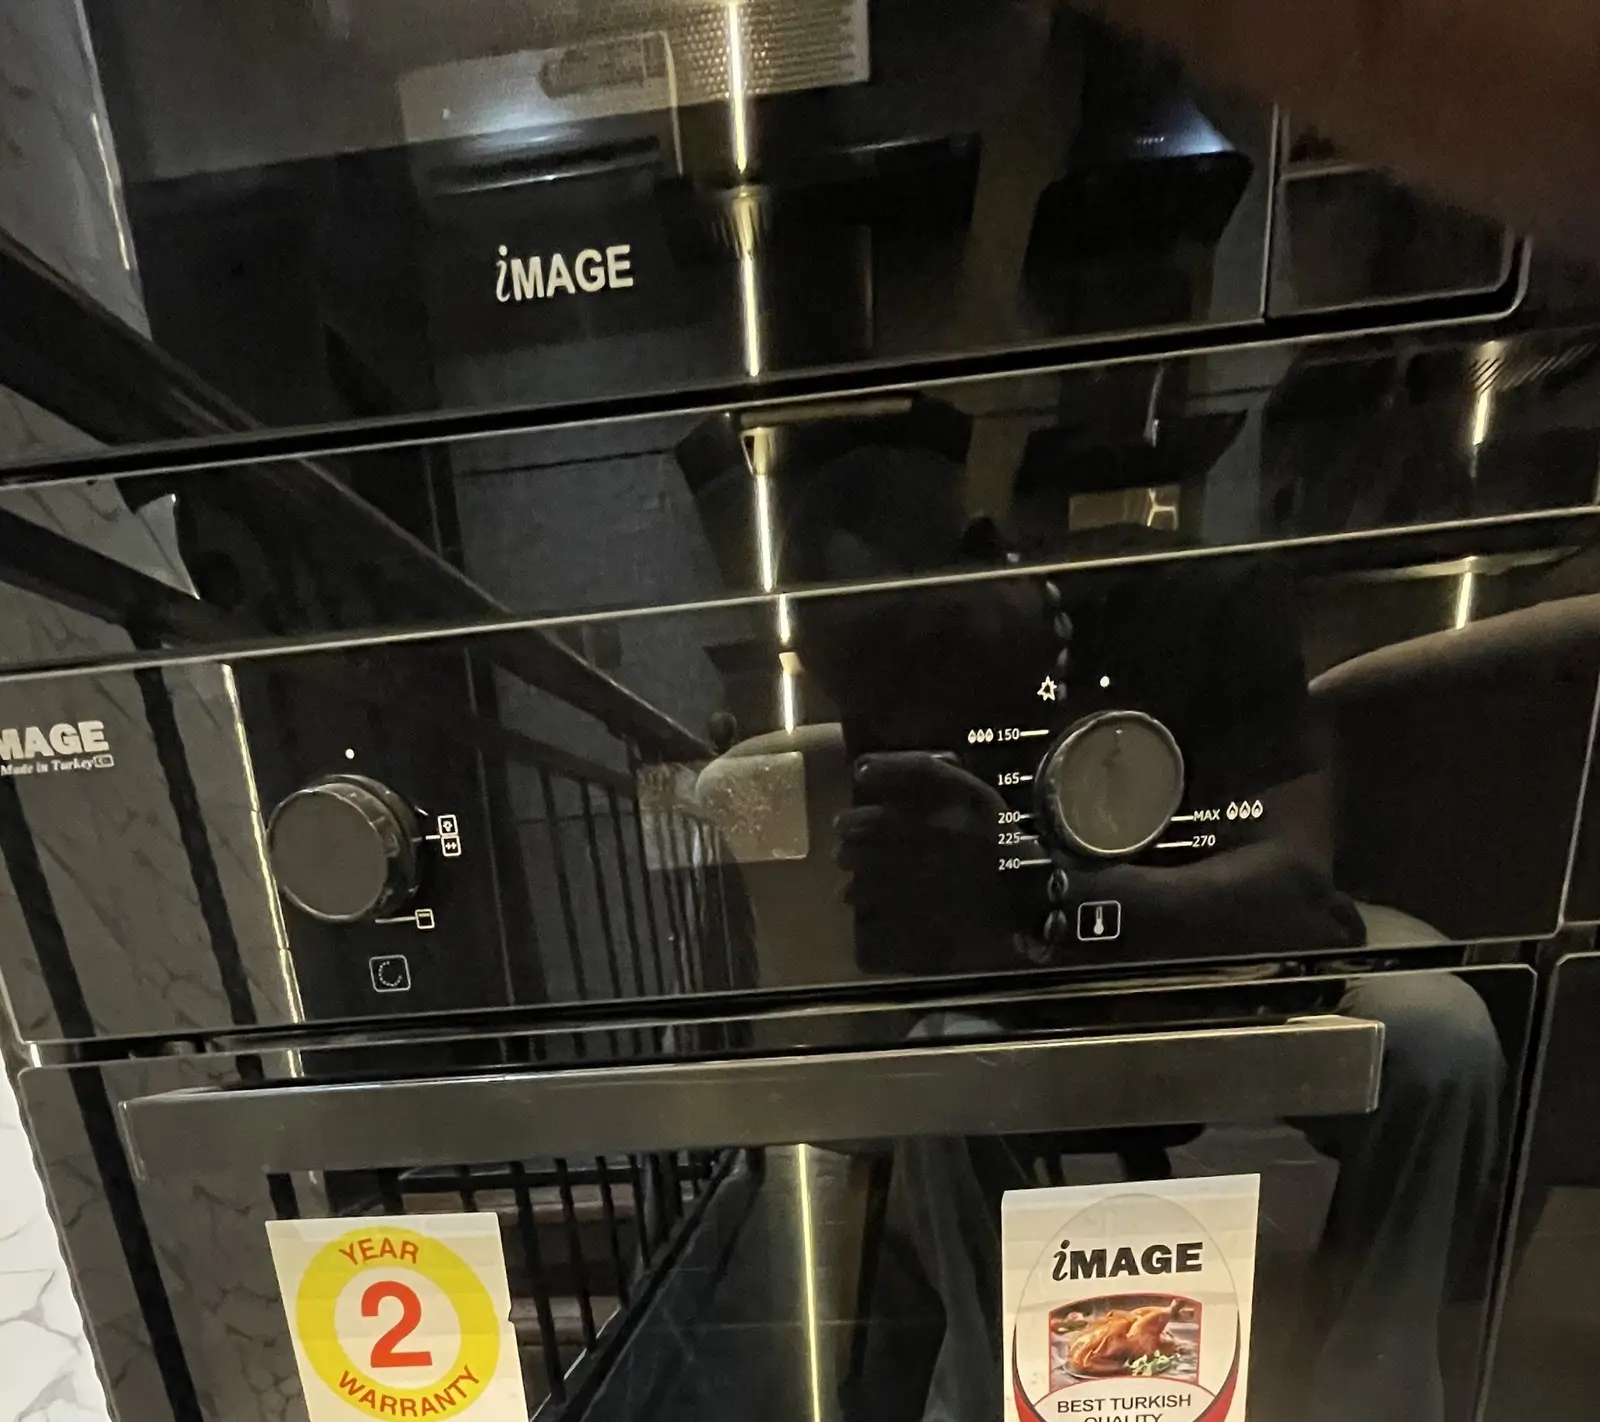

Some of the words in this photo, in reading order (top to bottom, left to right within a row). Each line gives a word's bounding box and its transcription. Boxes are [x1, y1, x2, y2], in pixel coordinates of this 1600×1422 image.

[496, 244, 634, 302] iMAGE
[998, 728, 1020, 741] 150
[51, 757, 93, 771] Turkey
[998, 772, 1020, 786] 165
[998, 811, 1021, 824] 200
[1193, 808, 1221, 821] MAX
[998, 832, 1021, 845] 225
[1192, 834, 1216, 848] 270
[998, 858, 1021, 870] 240
[338, 1237, 419, 1265] YEAR
[1052, 1239, 1204, 1281] iMAGE
[361, 1280, 433, 1369] 2
[338, 1365, 480, 1418] WARRANTY
[1057, 1399, 1106, 1413] BEST
[1110, 1394, 1192, 1410] TURKISH
